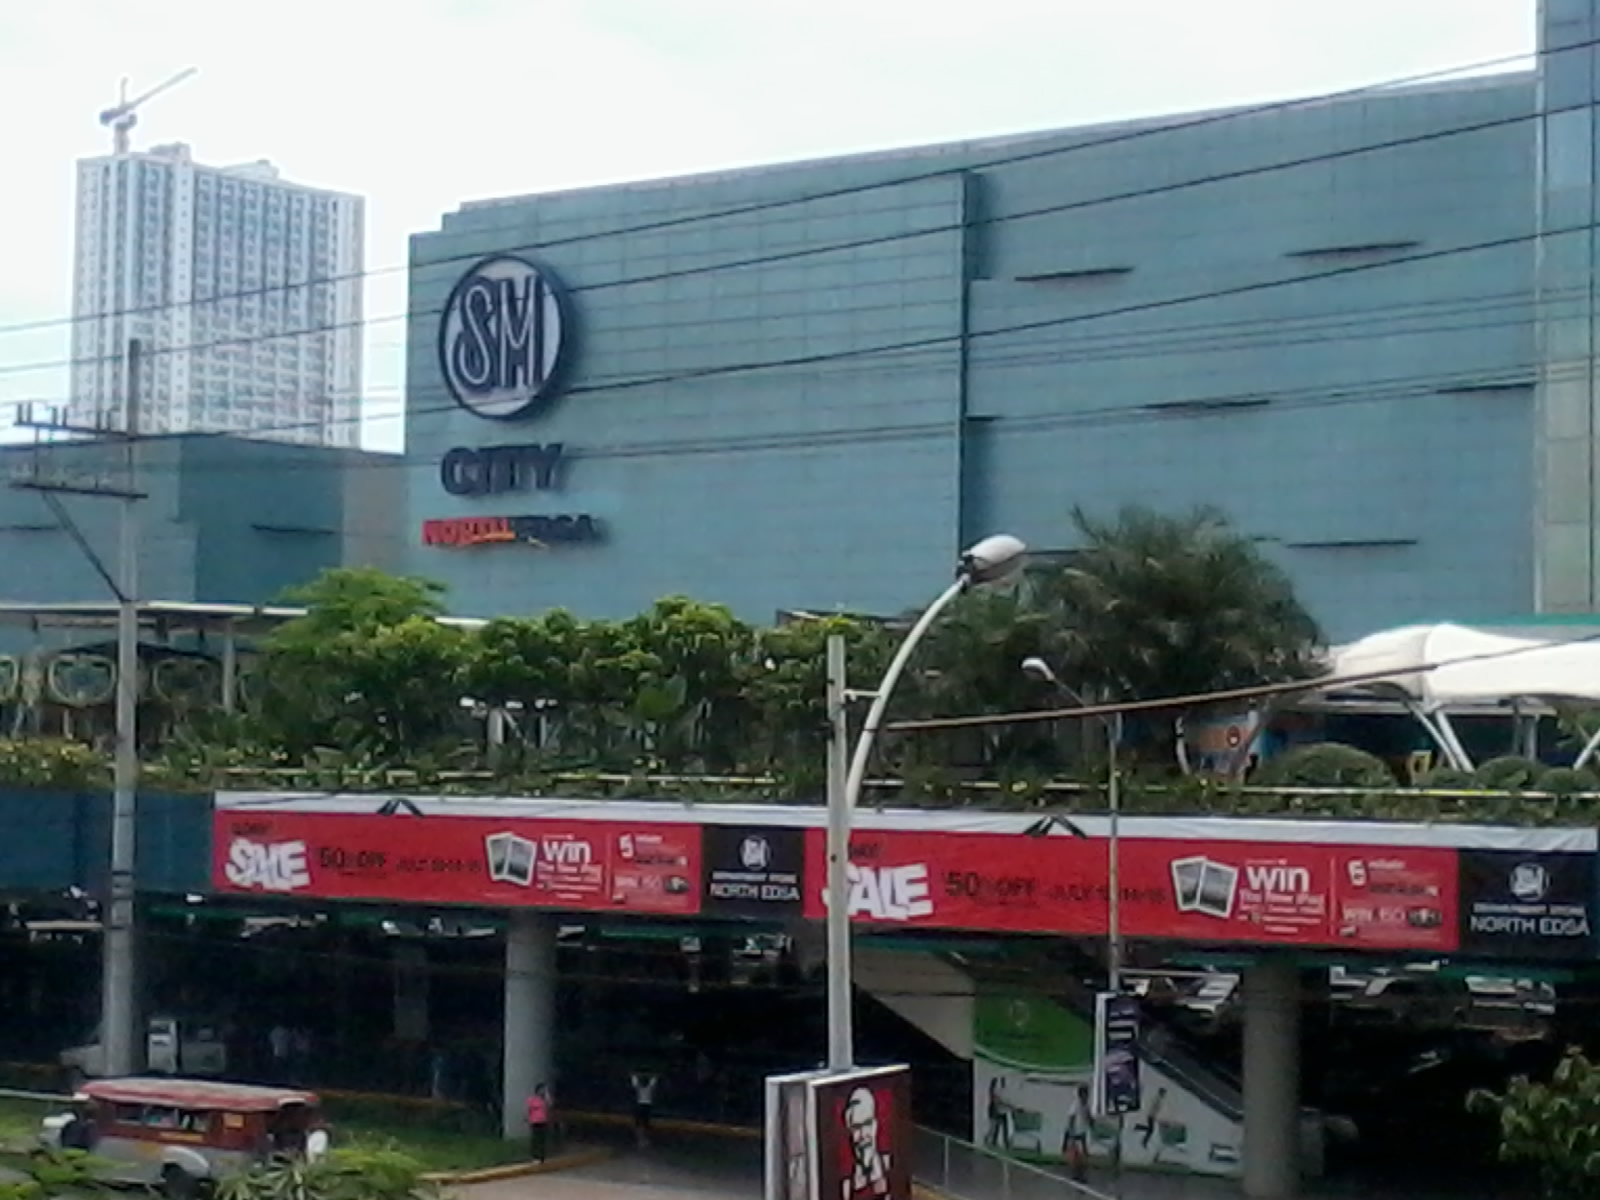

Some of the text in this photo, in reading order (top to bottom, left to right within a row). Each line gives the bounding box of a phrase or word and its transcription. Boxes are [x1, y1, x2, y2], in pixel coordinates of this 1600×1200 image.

[452, 275, 544, 392] SM
[441, 443, 563, 496] CITY
[225, 838, 311, 891] SALE
[542, 839, 592, 865] win
[710, 883, 759, 898] NORTH
[761, 884, 800, 900] EDSA
[1246, 865, 1310, 893] win
[1470, 915, 1591, 937] NORTH EDSA
